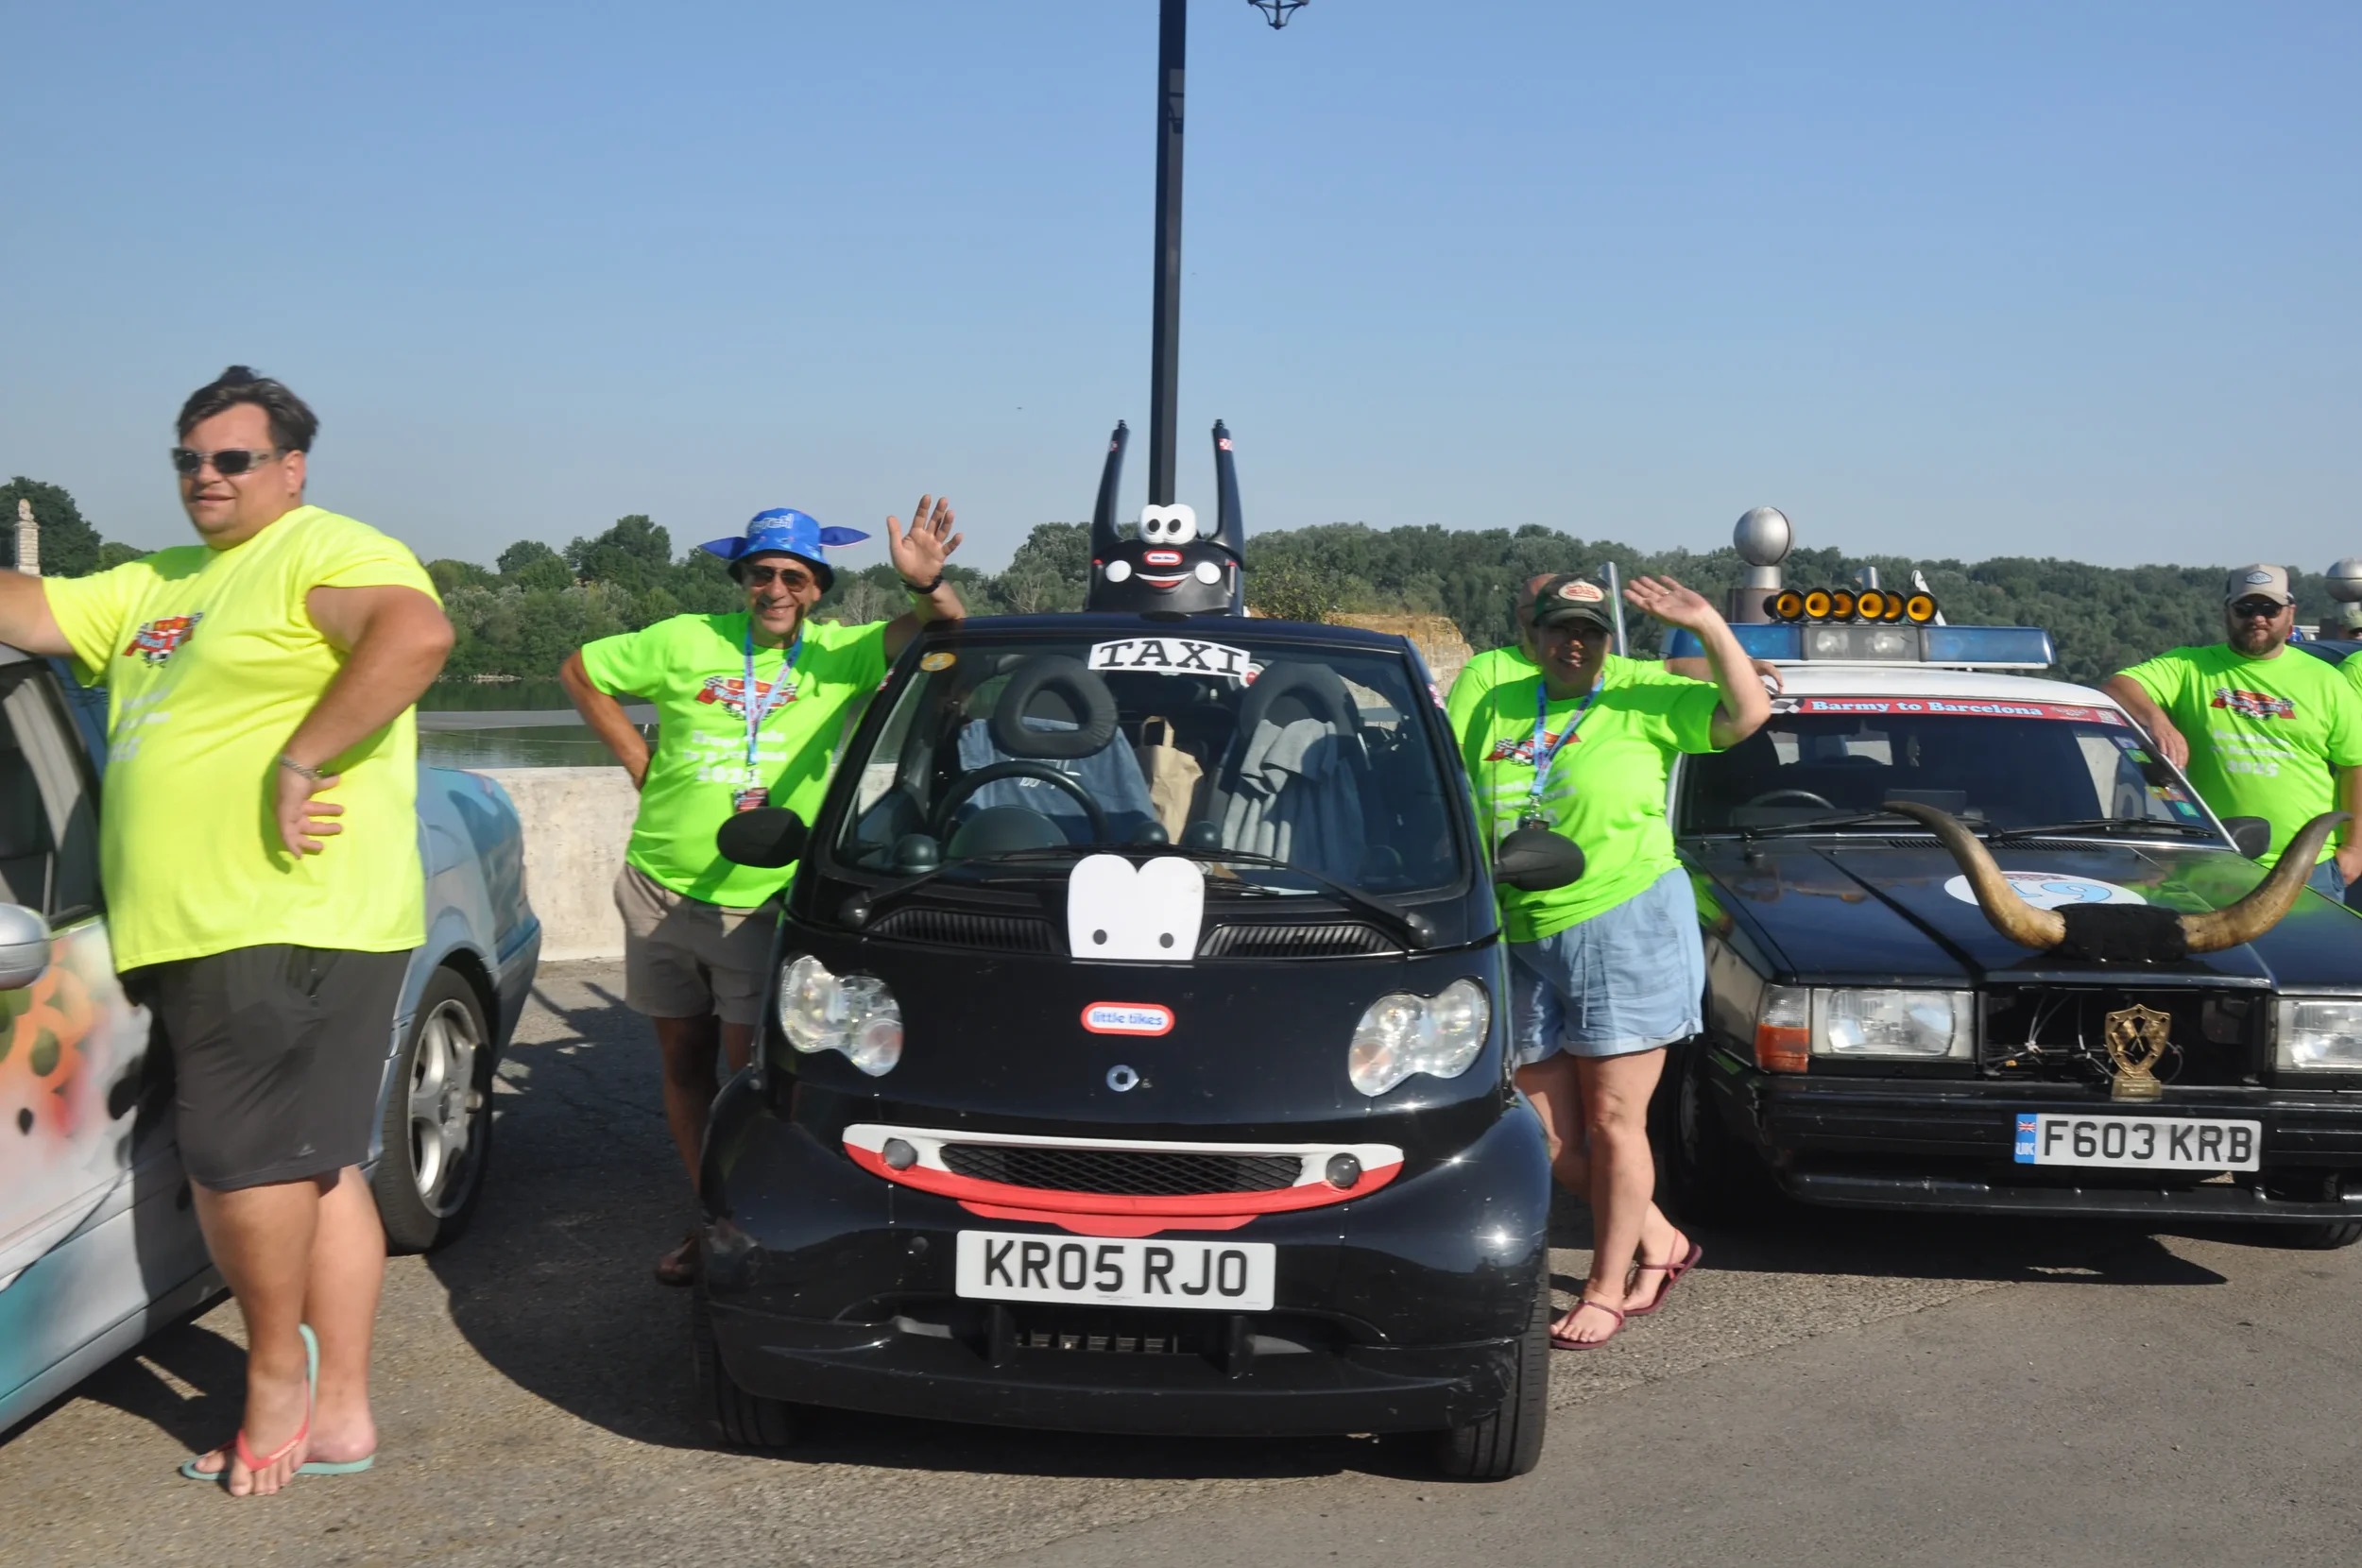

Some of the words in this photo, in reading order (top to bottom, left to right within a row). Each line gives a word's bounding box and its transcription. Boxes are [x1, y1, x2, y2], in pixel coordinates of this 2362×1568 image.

[1099, 639, 1242, 675] TAXI
[1811, 701, 1891, 713] Barmy
[1896, 702, 1923, 711] to
[1926, 702, 2044, 716] Barcelona
[1093, 1011, 1125, 1024] little
[1129, 1013, 1163, 1026] tikes
[2015, 1141, 2035, 1156] UK
[2044, 1119, 2156, 1160] F603
[2169, 1123, 2253, 1164] KRB
[984, 1238, 1126, 1293] KR05
[1142, 1246, 1248, 1298] RJO
